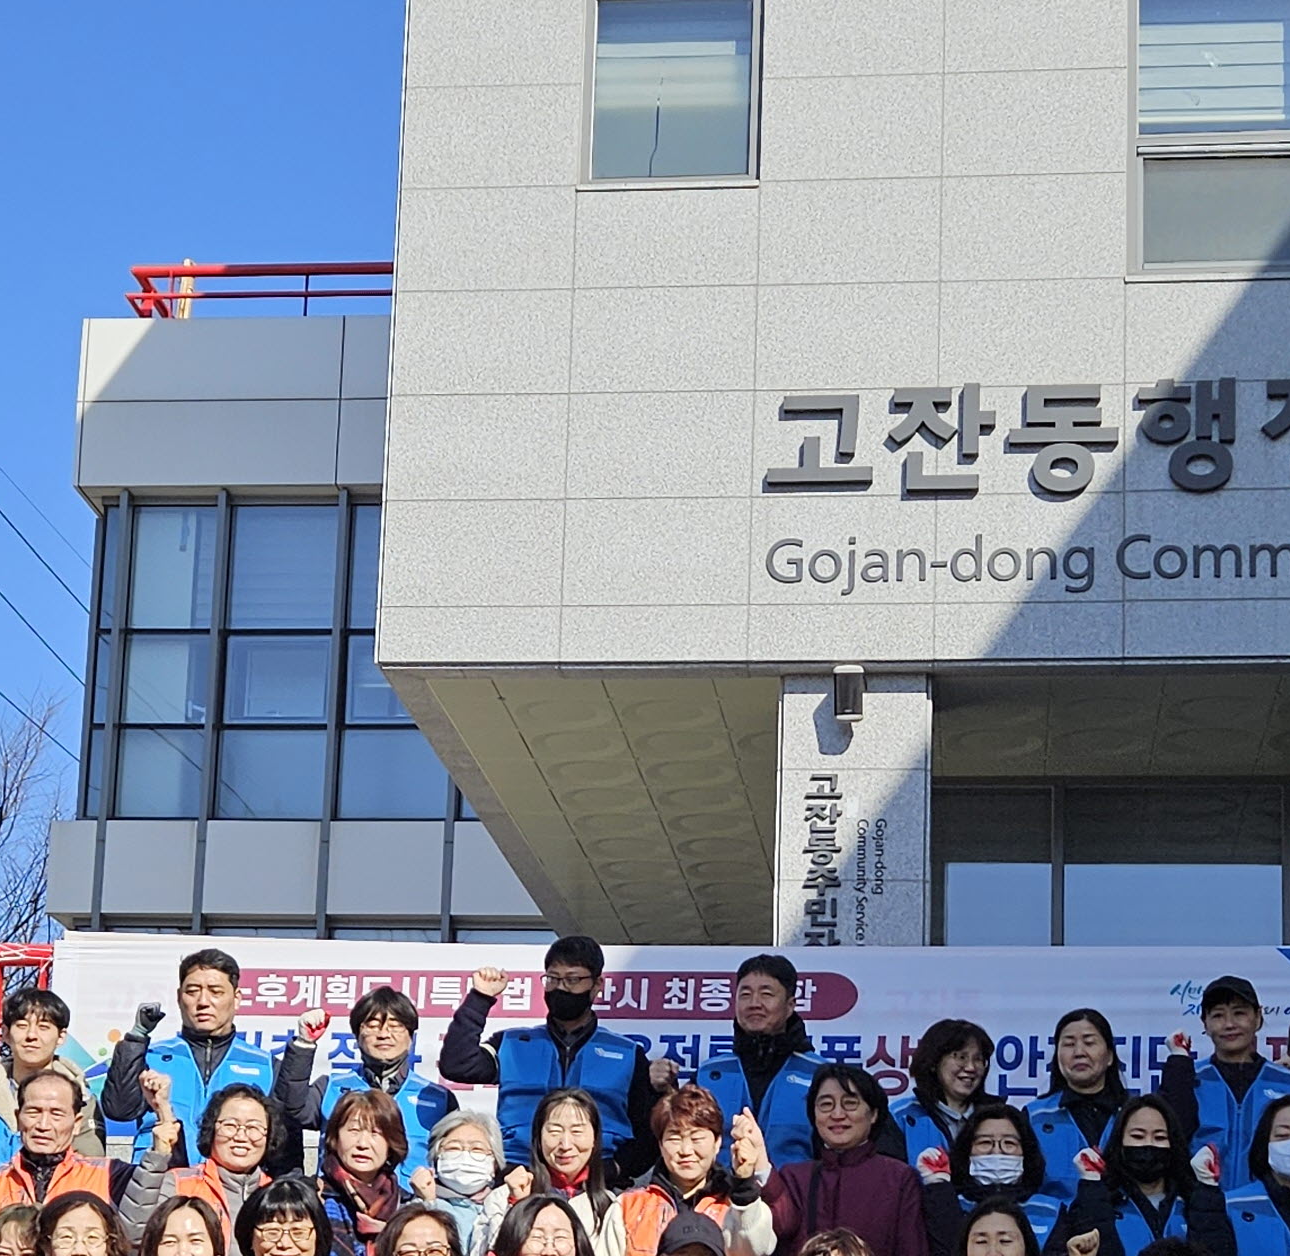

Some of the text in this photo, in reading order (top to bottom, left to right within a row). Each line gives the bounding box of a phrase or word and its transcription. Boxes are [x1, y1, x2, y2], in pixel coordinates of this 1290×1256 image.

[765, 533, 1095, 595] Gojan-dong
[853, 818, 870, 942] Community Service
[871, 818, 888, 896] Gojan-dong
[663, 978, 731, 1012] 최종
